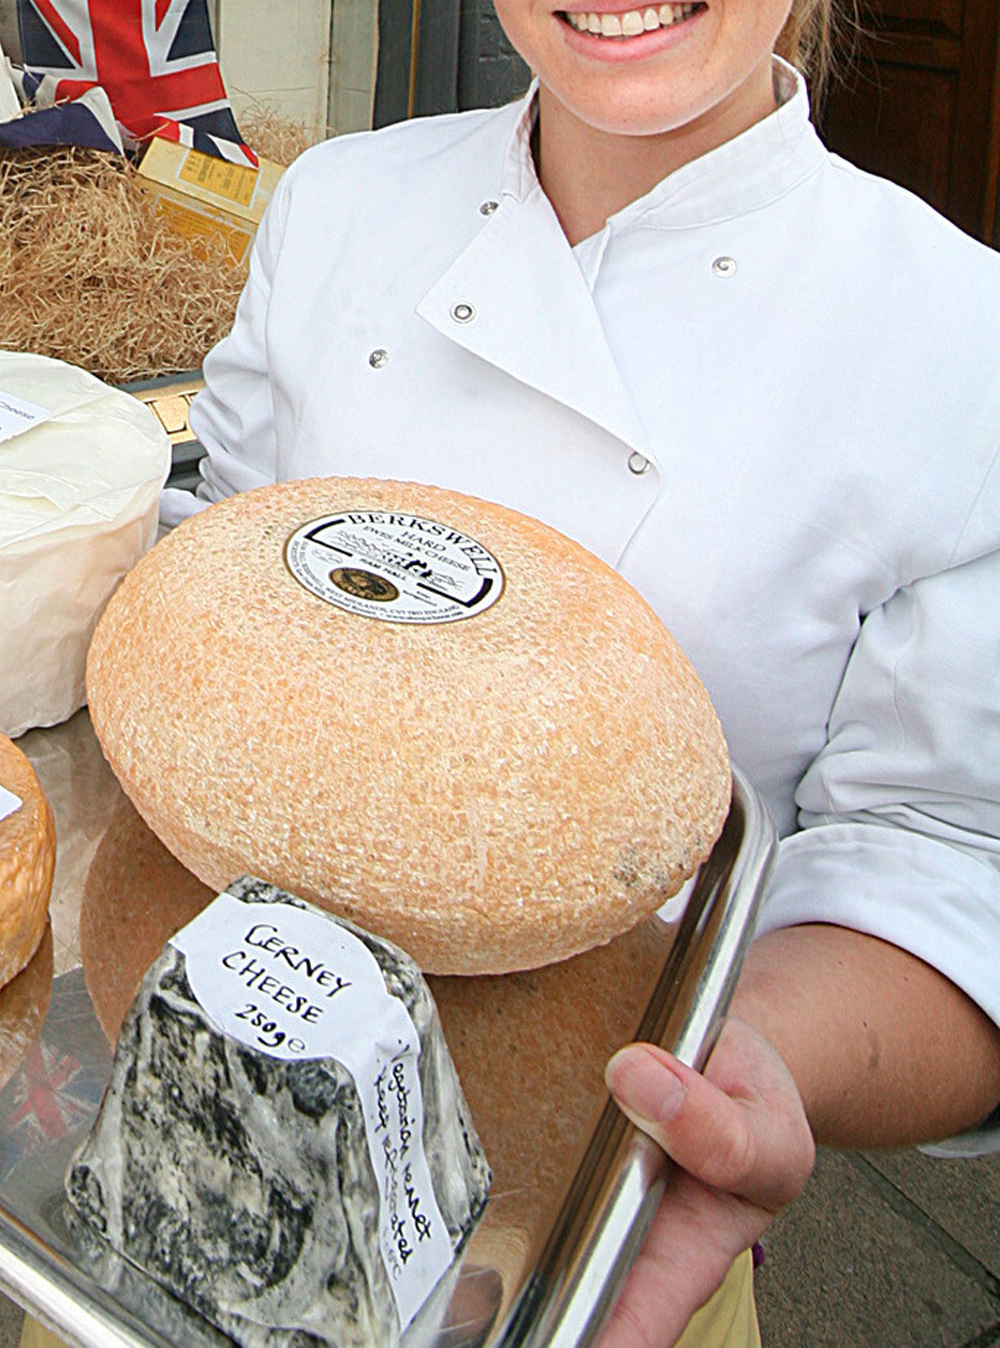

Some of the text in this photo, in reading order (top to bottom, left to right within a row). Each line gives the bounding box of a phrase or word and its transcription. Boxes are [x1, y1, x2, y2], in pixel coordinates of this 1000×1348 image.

[347, 513, 499, 576] BERKSWELL
[393, 537, 423, 554] MILK
[424, 548, 472, 572] CHEESE
[400, 530, 448, 553] HARD
[221, 951, 325, 1024] CHEESE
[243, 923, 353, 998] CERNEY
